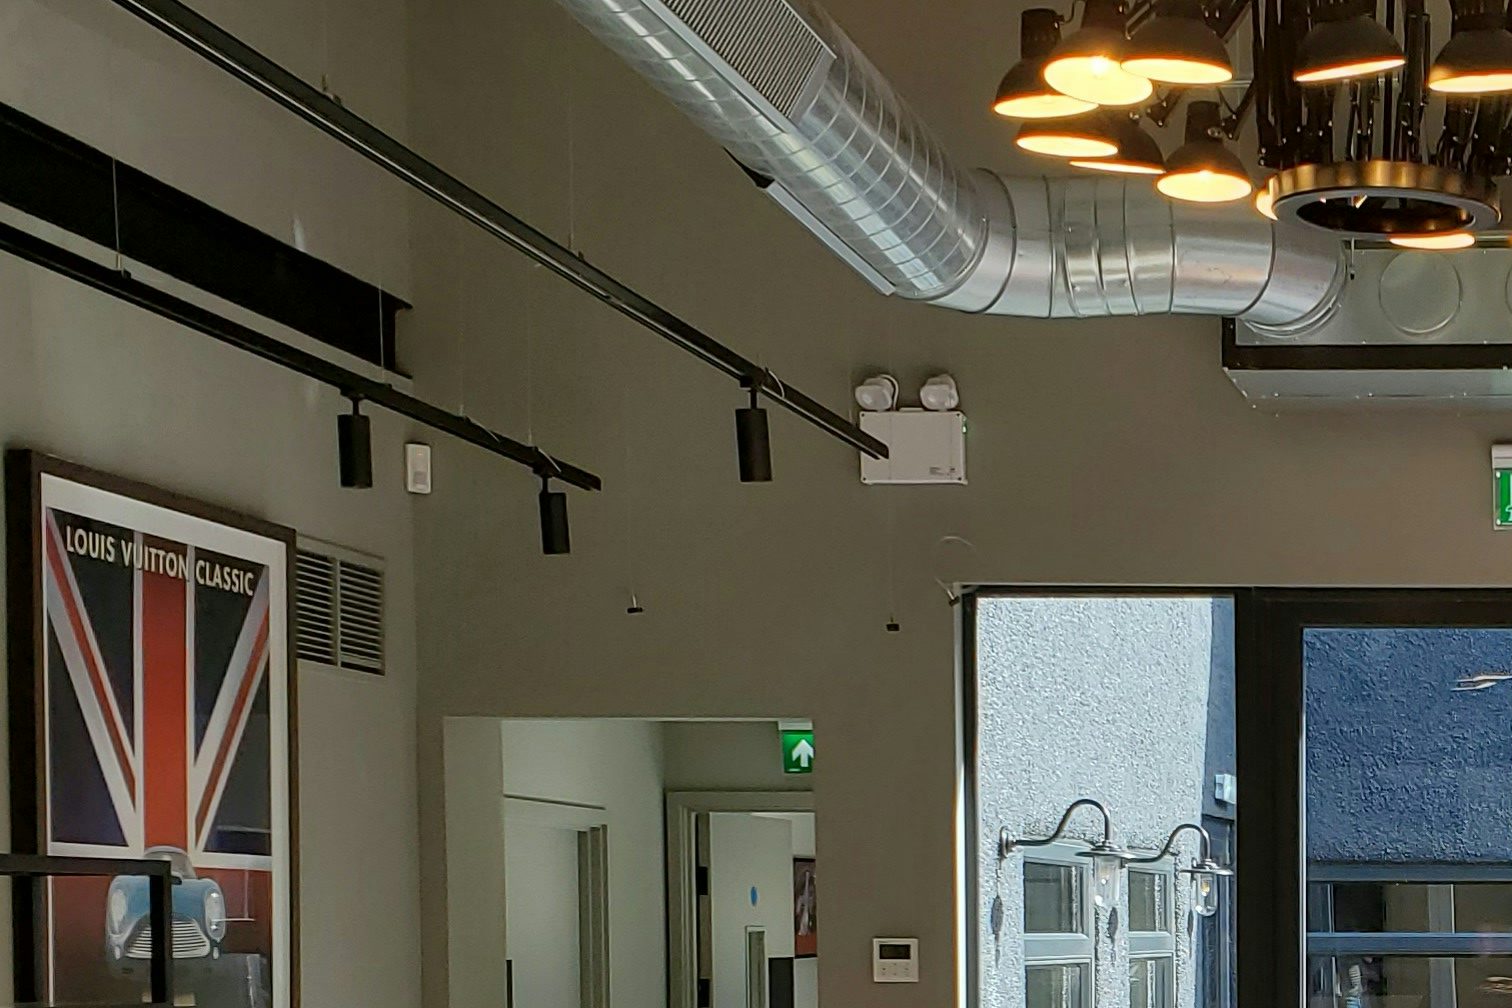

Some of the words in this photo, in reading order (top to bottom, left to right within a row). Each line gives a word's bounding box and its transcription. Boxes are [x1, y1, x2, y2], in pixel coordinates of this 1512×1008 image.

[66, 525, 116, 563] LOUIS
[121, 539, 190, 582] VUITTON
[195, 560, 255, 597] CLASSIC
